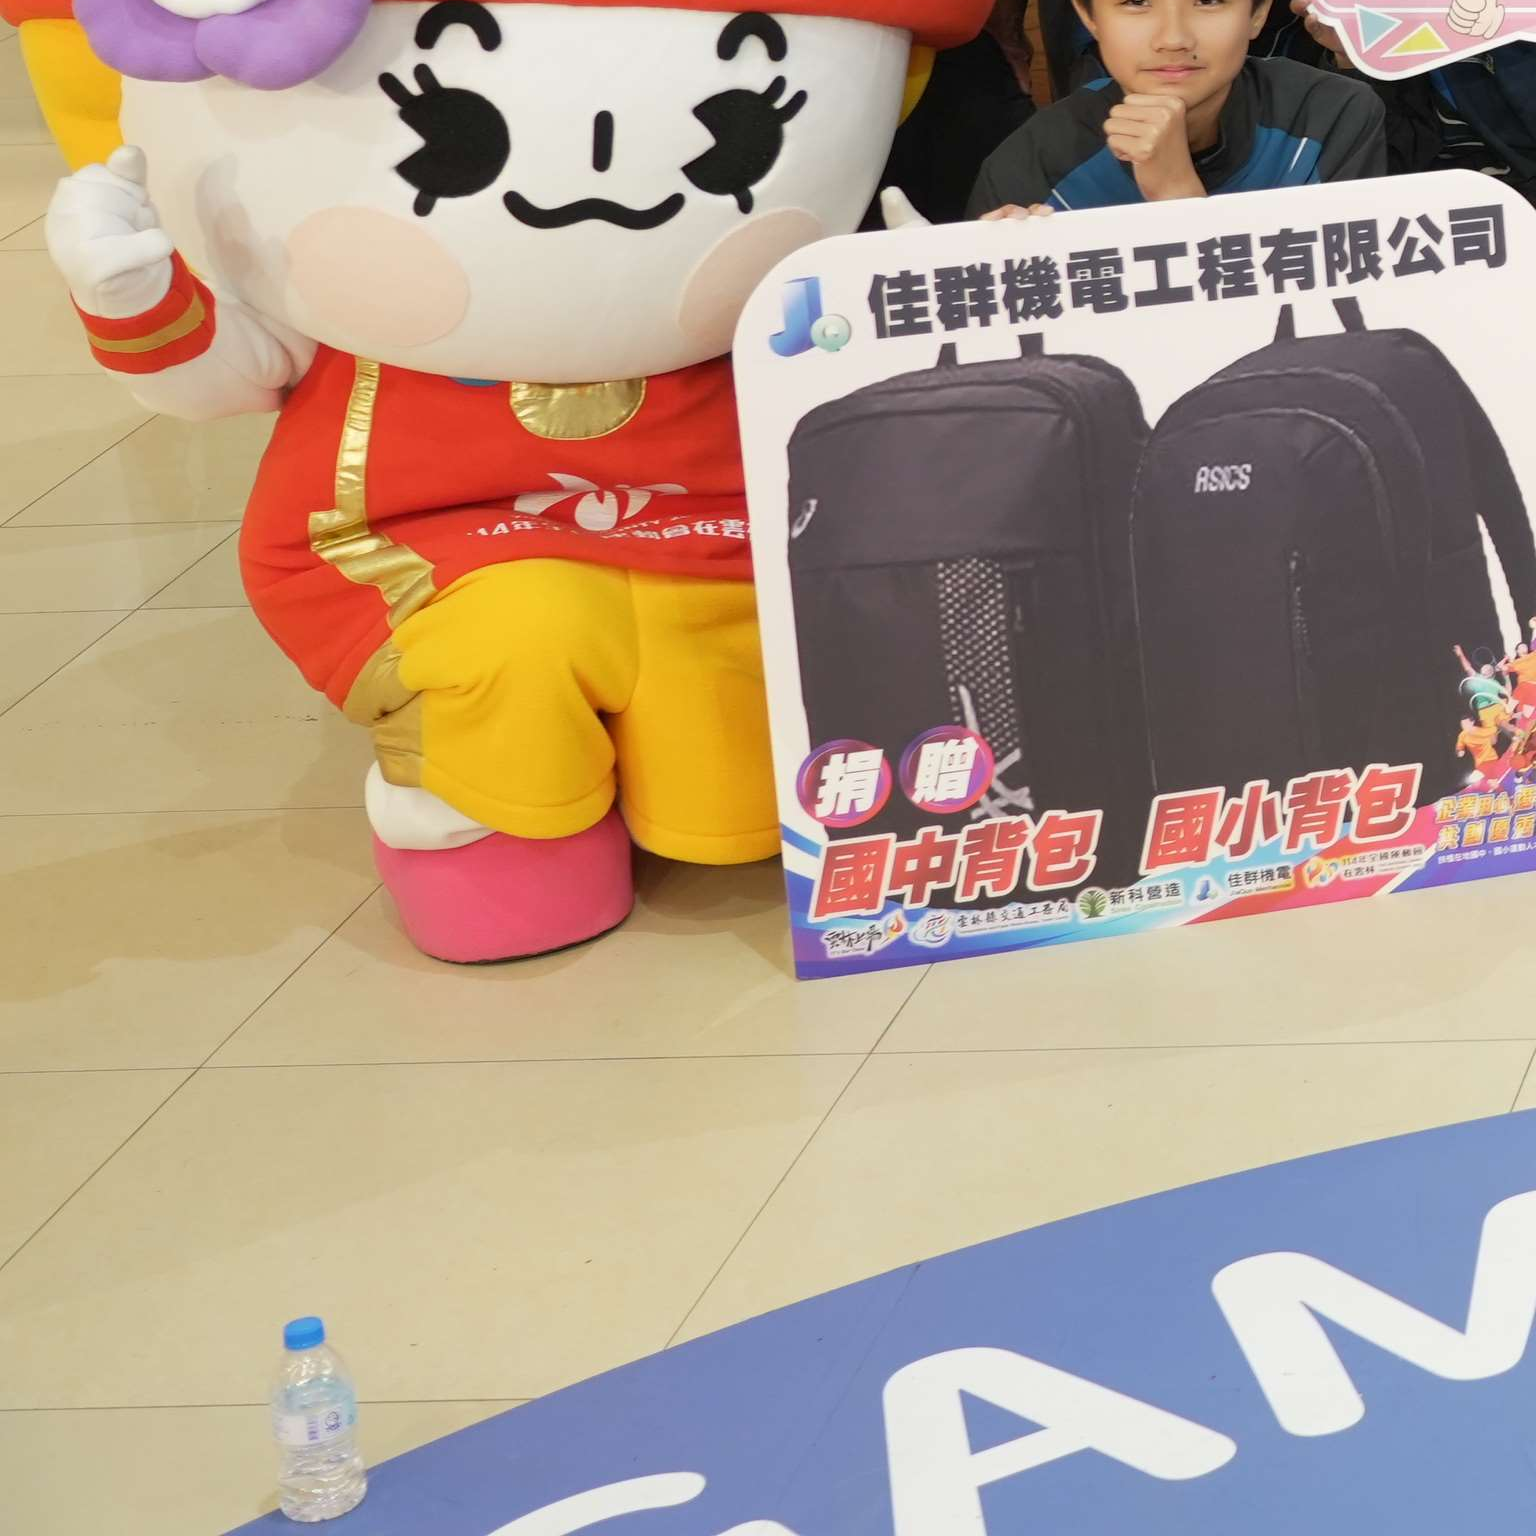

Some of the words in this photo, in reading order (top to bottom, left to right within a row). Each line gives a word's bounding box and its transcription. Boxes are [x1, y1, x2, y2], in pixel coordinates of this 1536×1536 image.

[867, 204, 1507, 340] 佳群機電工程有限公司
[814, 810, 1102, 916] 國中背包
[1145, 765, 1420, 870] 國小背包
